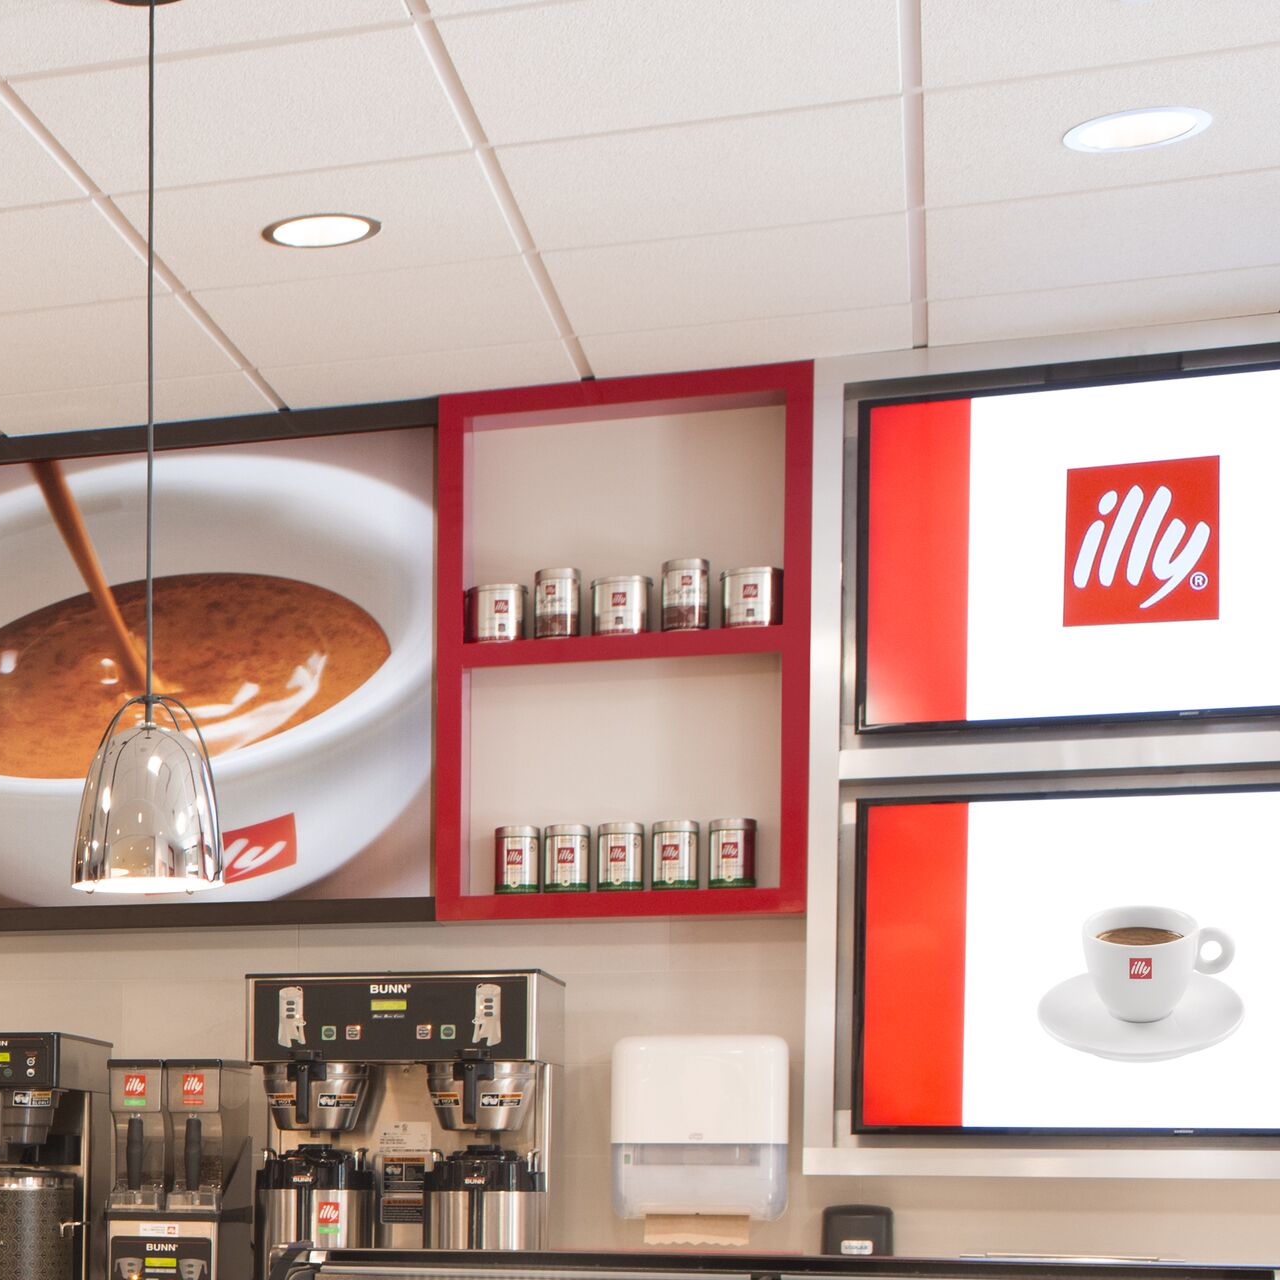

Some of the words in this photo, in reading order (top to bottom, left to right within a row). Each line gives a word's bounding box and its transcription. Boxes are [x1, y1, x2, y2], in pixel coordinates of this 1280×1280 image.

[1073, 485, 1210, 609] illy
[507, 851, 522, 865] illy
[559, 850, 574, 863] illy
[610, 849, 626, 862] illy
[663, 846, 679, 860] illy
[722, 844, 738, 858] illy
[223, 838, 287, 880] ly
[1130, 960, 1151, 977] illy
[370, 984, 408, 994] BUNN
[126, 1077, 145, 1095] illy
[184, 1077, 203, 1094] illy
[320, 1203, 339, 1221] illy
[146, 1243, 176, 1252] BUNN
